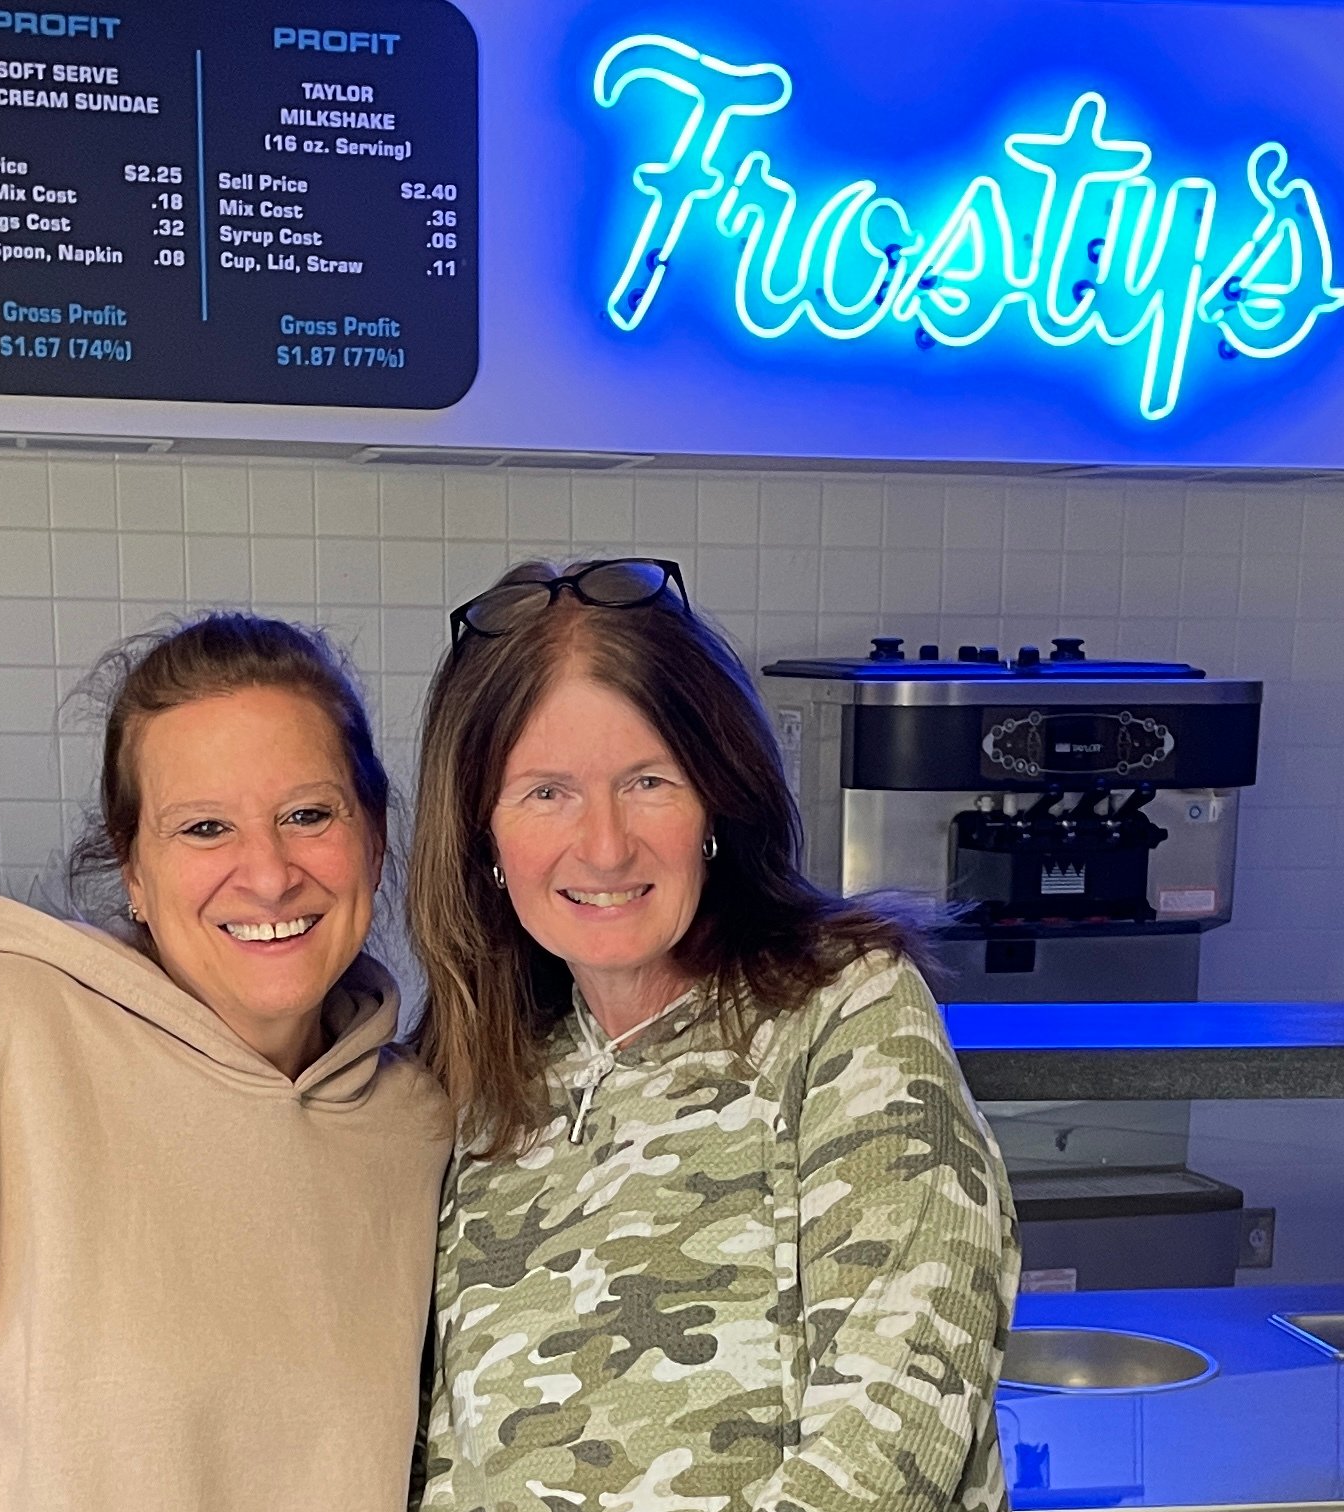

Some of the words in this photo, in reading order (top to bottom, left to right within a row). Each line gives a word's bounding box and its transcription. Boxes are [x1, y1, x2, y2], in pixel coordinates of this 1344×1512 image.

[274, 28, 400, 55] PROFIT
[53, 65, 118, 84] SERVE
[75, 93, 159, 113] SUNDAE
[302, 83, 373, 102] TAYLOR
[281, 108, 395, 130] MILKSHAKE
[265, 134, 296, 151] (16
[304, 141, 329, 153] oz.
[336, 138, 411, 160] Serving)
[125, 165, 182, 183] $2.25
[219, 173, 252, 190] Sell
[260, 175, 307, 192] Price
[401, 183, 456, 200] $2.40
[33, 186, 77, 203] Cost
[152, 193, 182, 210] .18
[220, 199, 253, 216] Mix
[260, 201, 303, 218] Cost
[427, 210, 456, 226] .36
[27, 214, 70, 231] Cost
[154, 219, 184, 236] .32
[220, 226, 273, 247] Syrup
[280, 229, 322, 245] Cost
[427, 233, 456, 248] .06
[59, 244, 122, 265] Napkin
[154, 250, 184, 266] .08
[221, 252, 260, 272] Cup,
[268, 254, 300, 273] Lid,
[307, 256, 363, 273] Straw
[427, 261, 455, 276] .11
[3, 301, 61, 323] Gross
[69, 304, 127, 325] Profit
[281, 315, 337, 335] Gross
[345, 317, 400, 337] Profit
[0, 335, 60, 358] $1.67
[69, 339, 131, 361] (74%)
[277, 346, 335, 365] $1.87
[344, 347, 404, 367] (77%)
